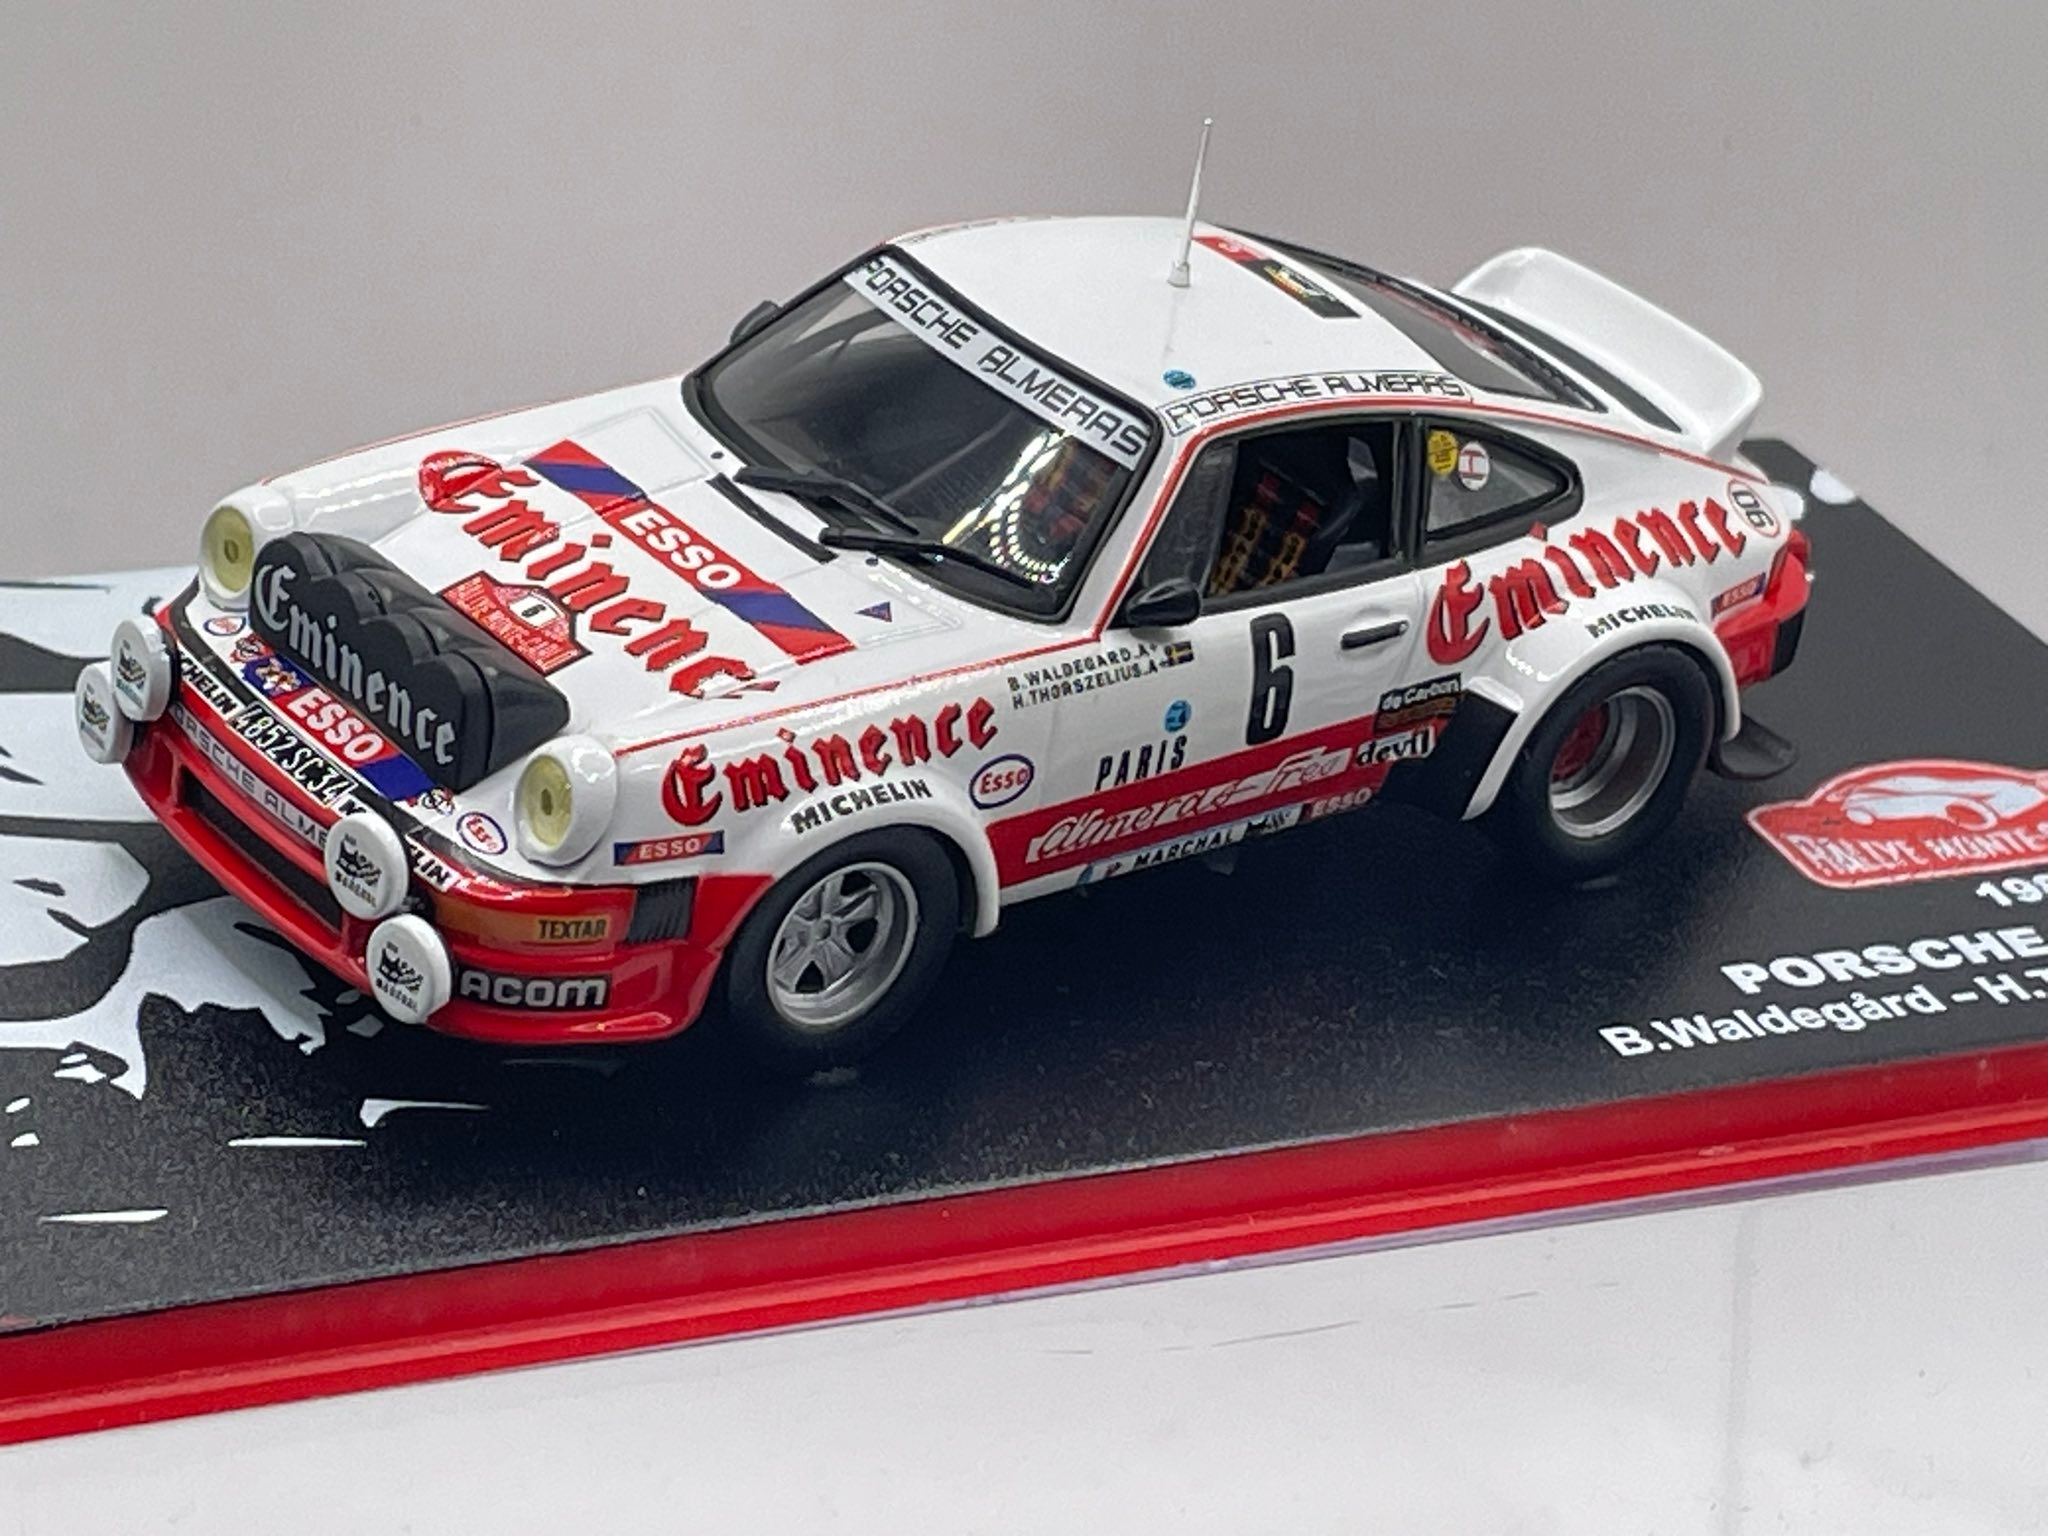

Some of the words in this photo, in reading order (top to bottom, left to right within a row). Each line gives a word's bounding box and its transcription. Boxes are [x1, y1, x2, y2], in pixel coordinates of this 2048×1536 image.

[855, 257, 980, 350] PORSCHE
[976, 344, 1152, 457] ALMERAS
[1166, 378, 1320, 431] PORSCHE
[620, 509, 742, 589] ESSO
[1426, 497, 1746, 665] Eminence
[1584, 603, 1699, 639] MICHELIN
[254, 562, 457, 766] Eminence
[1246, 612, 1296, 746] 6
[286, 687, 384, 762] ESSO
[1356, 727, 1430, 767] devil
[174, 702, 256, 795] ORSCHE
[264, 789, 329, 850] ALME
[661, 695, 999, 828] Eminence
[978, 767, 1031, 797] Esso
[1094, 734, 1188, 792] PARIS
[789, 778, 933, 835] MICHELIN
[1310, 786, 1373, 818] ESSO
[638, 837, 701, 860] ESSO
[1132, 825, 1236, 868] MARCHAL
[1785, 832, 1930, 877] RALLYE
[538, 918, 607, 940] TEXTAR
[1720, 925, 2048, 995] PORSCHE
[1600, 984, 1948, 1057] B.Waldegård
